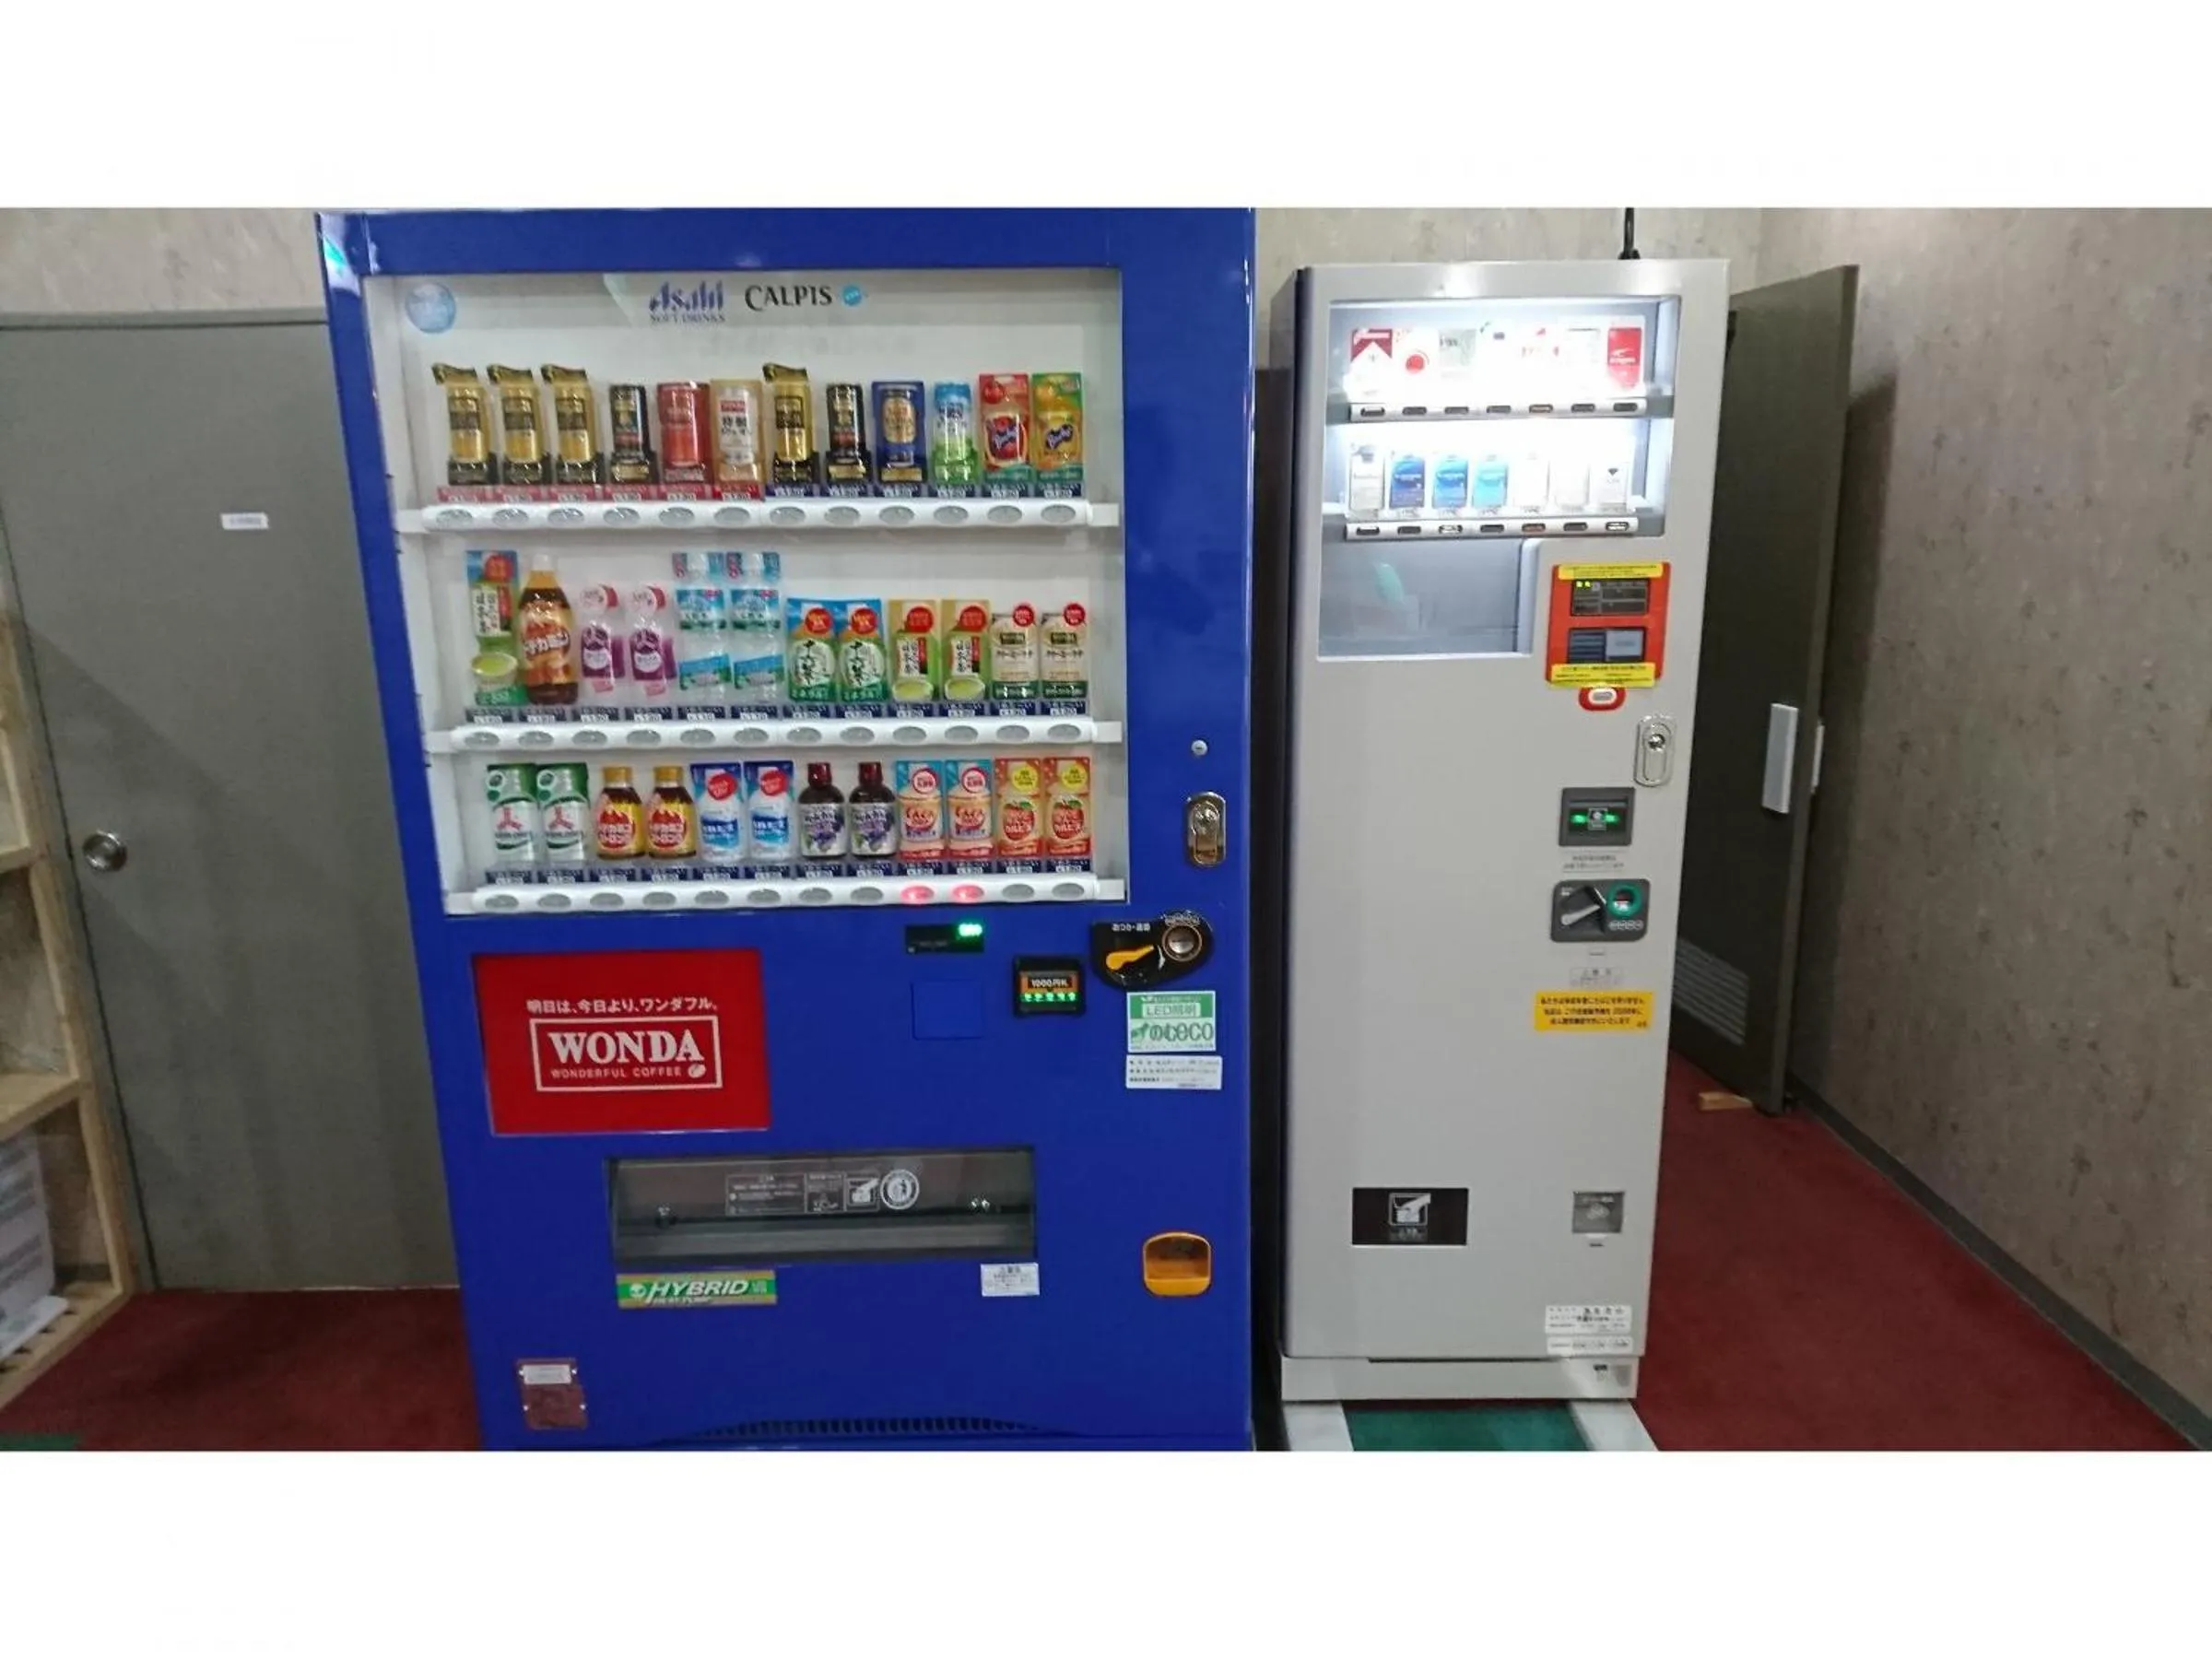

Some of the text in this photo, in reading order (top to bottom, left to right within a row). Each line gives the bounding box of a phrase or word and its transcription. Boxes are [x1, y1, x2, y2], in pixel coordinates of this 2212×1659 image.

[649, 281, 724, 311] Asahi
[745, 285, 833, 312] CALPIS
[547, 1028, 705, 1065] WONDA
[551, 1065, 682, 1079] WONDERFUL COFFEE
[645, 1279, 750, 1304] HYBRID
